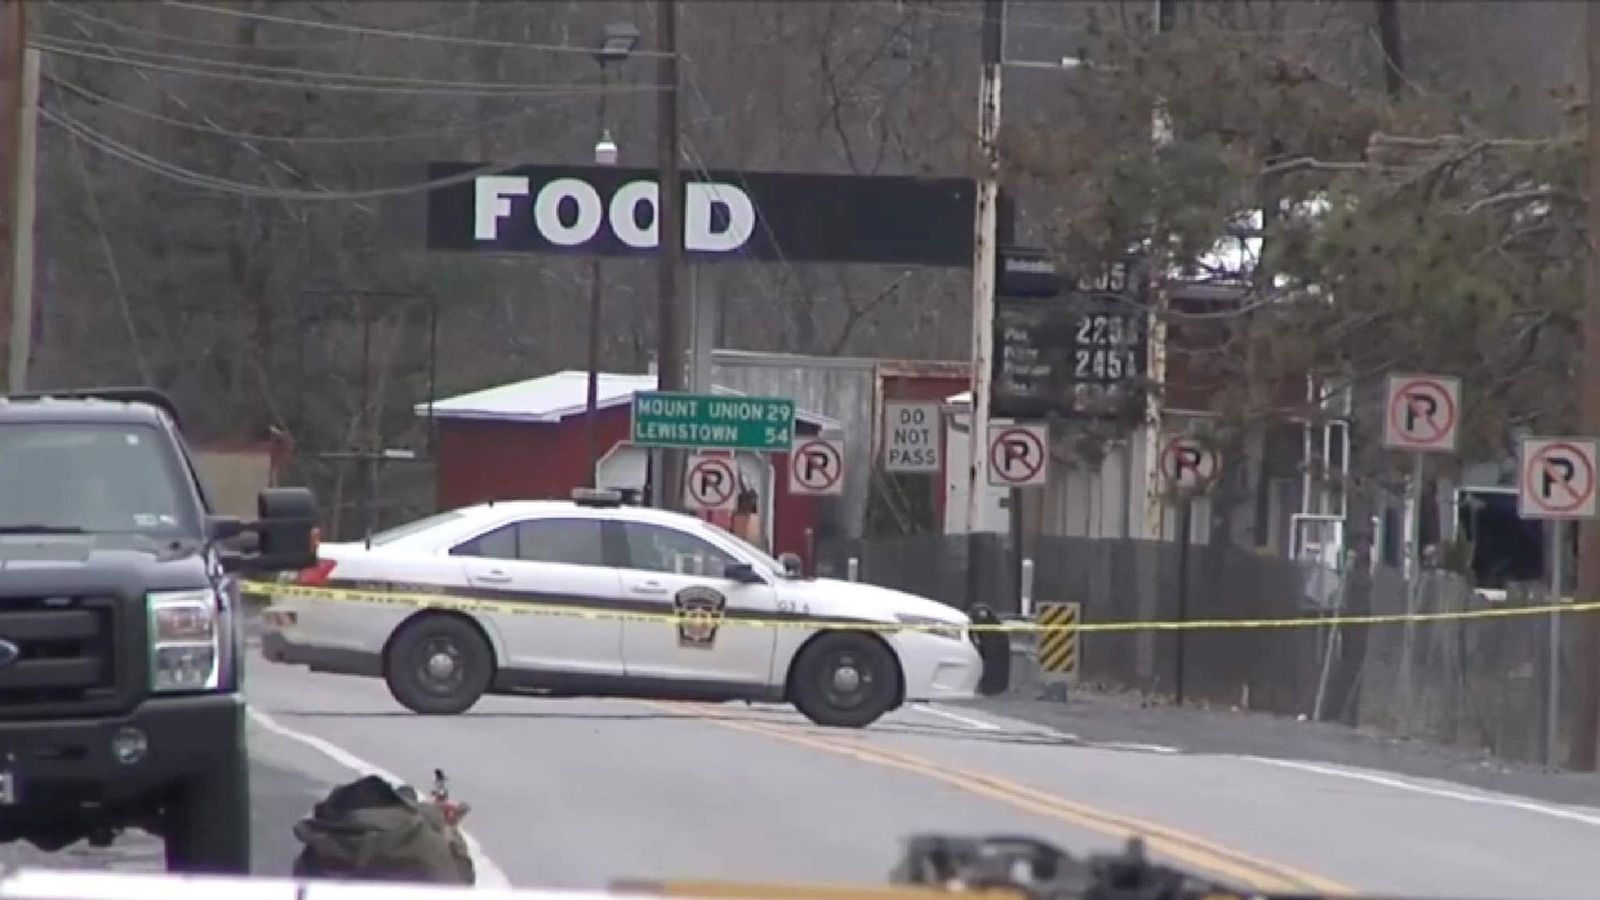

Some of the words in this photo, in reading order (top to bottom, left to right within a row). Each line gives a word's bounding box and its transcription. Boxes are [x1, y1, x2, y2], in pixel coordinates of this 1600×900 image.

[475, 175, 756, 251] FOOD
[637, 401, 698, 418] MOUNT
[709, 403, 764, 420] UNION
[766, 404, 791, 421] 29
[900, 408, 925, 425] DO
[635, 422, 738, 441] LEWISTOWN
[764, 428, 789, 445] 54
[894, 429, 931, 445] NOT
[889, 448, 937, 466] PASS
